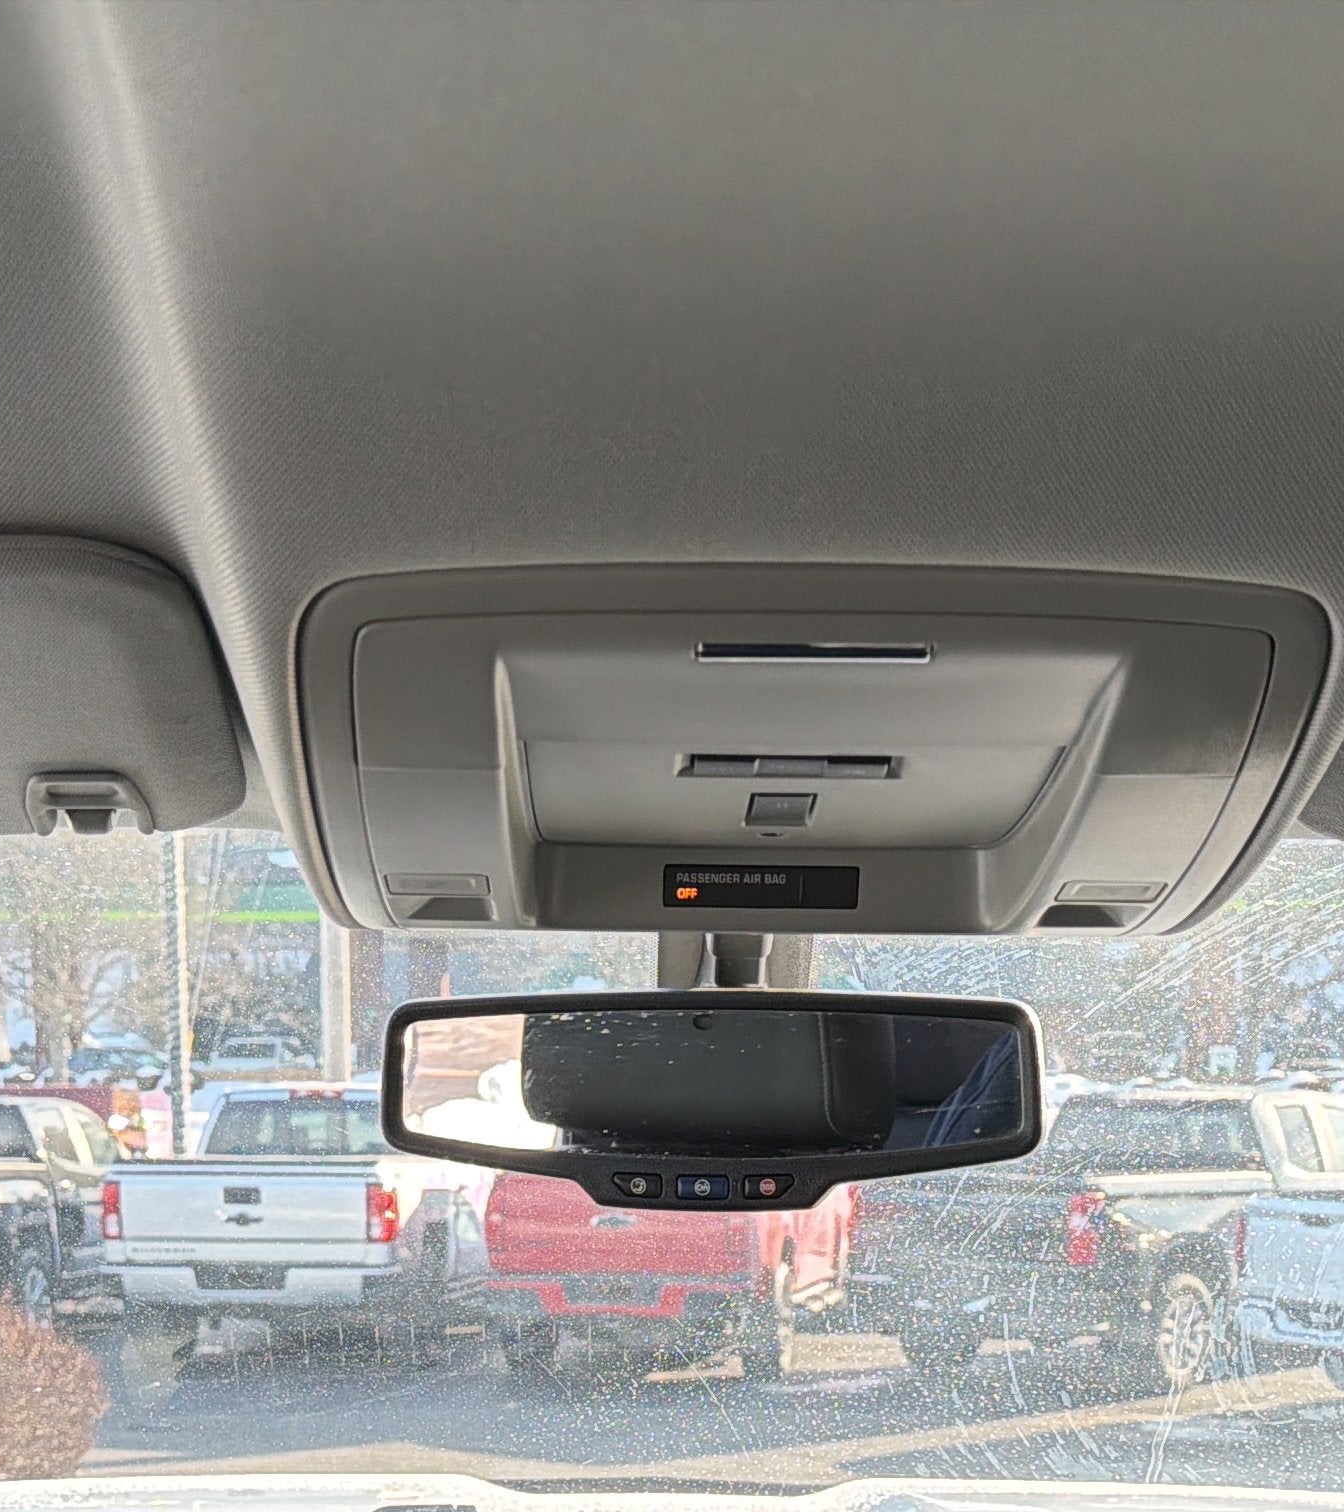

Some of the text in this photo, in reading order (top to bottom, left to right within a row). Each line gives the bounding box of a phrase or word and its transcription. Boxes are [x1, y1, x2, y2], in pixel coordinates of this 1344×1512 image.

[676, 872, 786, 885] PASSENGER AIR BAG
[676, 887, 698, 900] OFF
